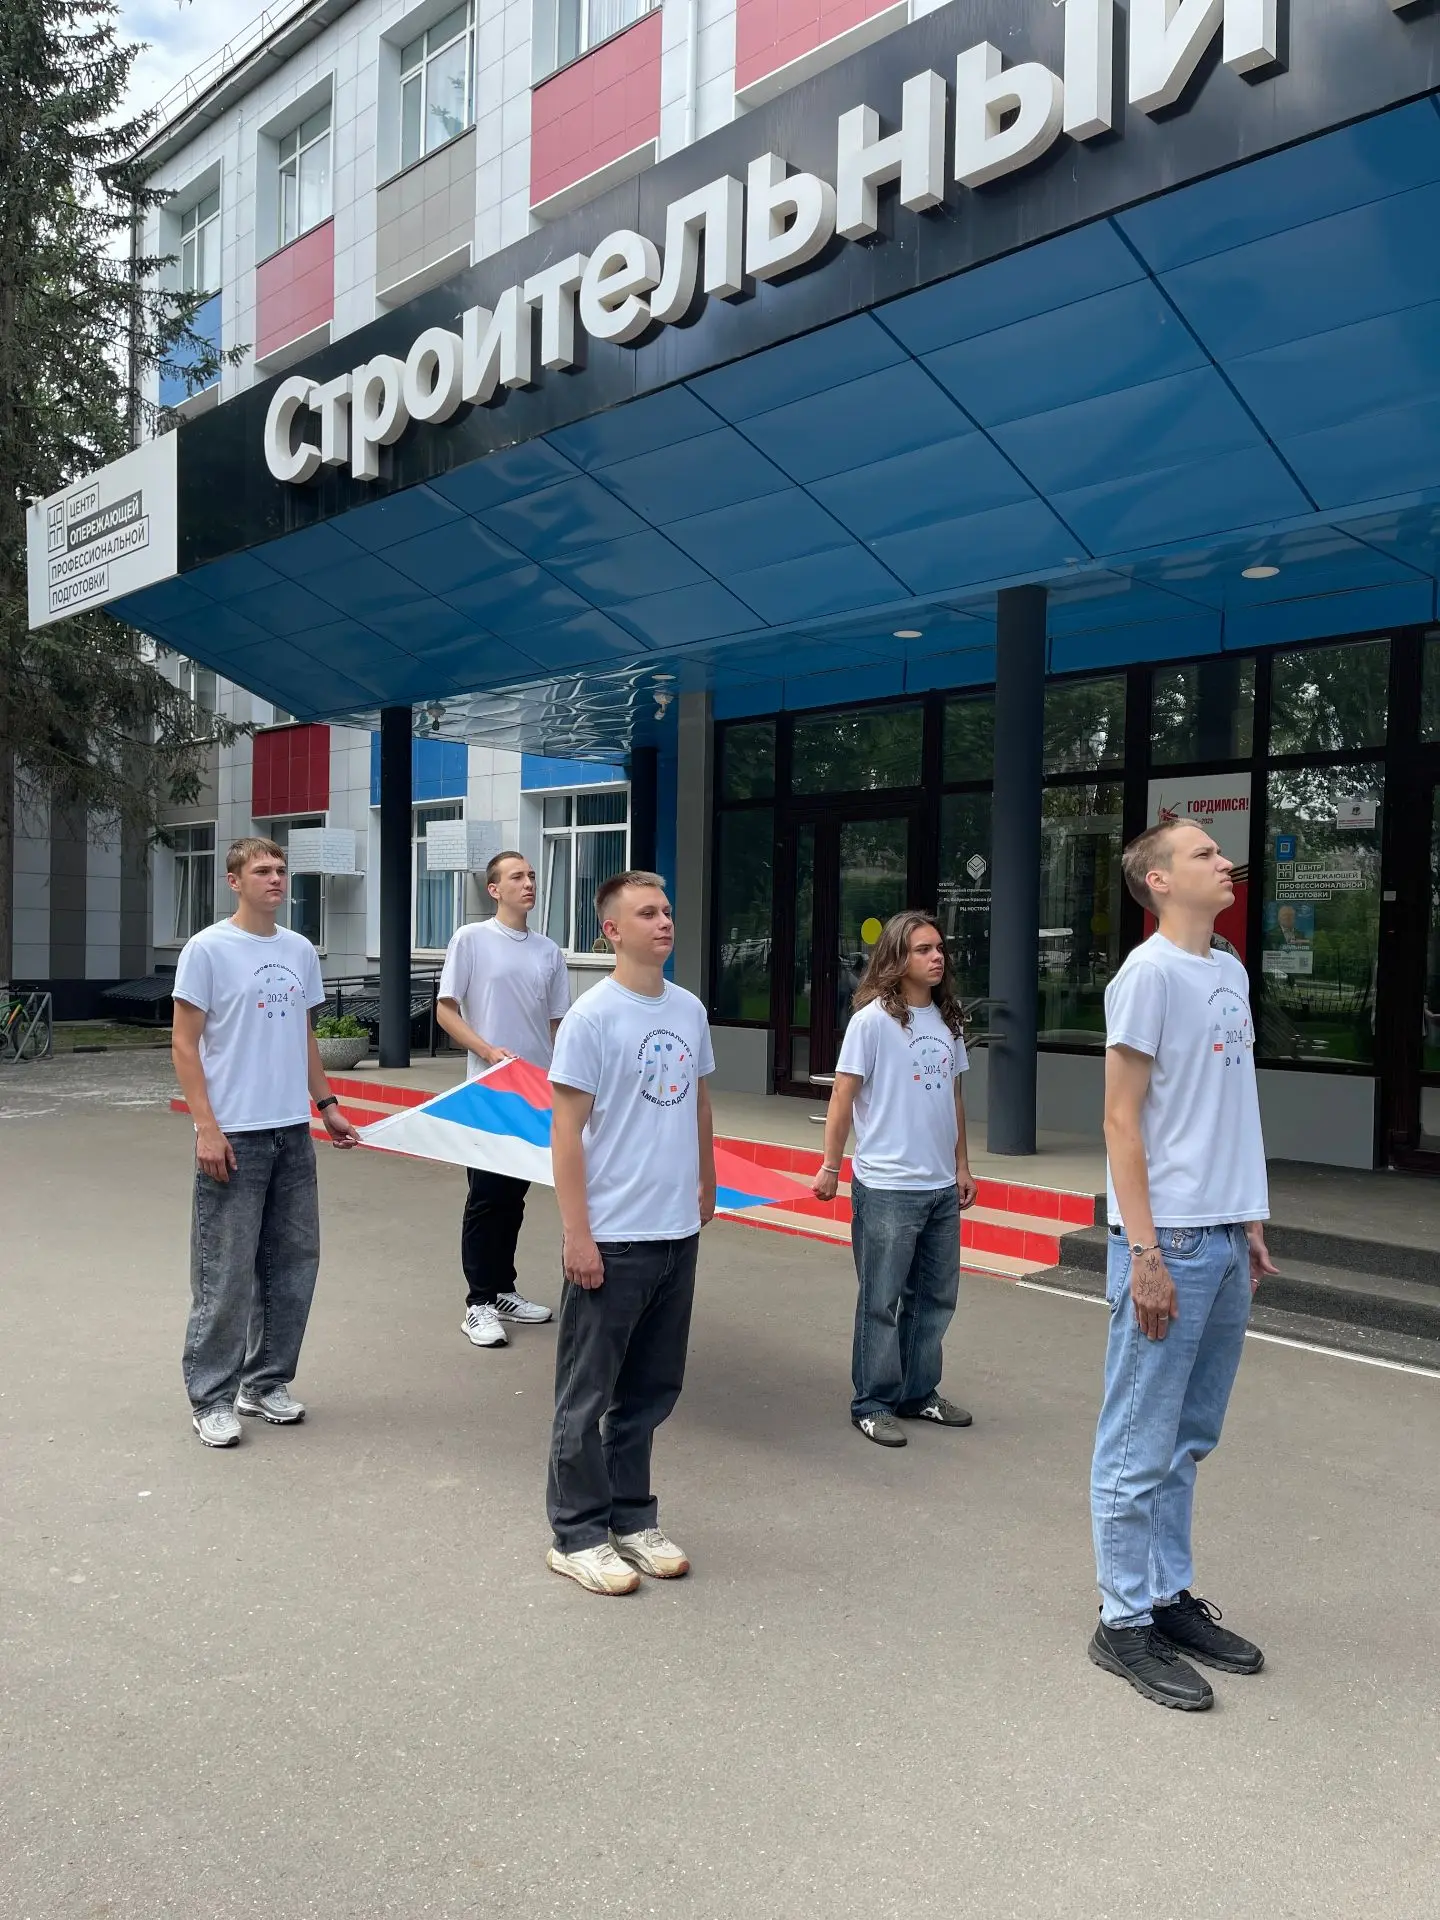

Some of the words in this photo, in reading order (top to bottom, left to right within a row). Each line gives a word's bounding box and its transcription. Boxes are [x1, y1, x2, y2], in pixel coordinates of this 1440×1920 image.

[69, 493, 97, 519] ЦЕНТР
[69, 496, 140, 546] ОПЕРЕЖАЮЩЕЙ
[51, 521, 146, 580] ПРОФЕССИОНАЛЬНОЙ
[52, 571, 106, 606] ПОДГОТОВКИ
[1187, 798, 1249, 814] ГОРДИМСЯ!
[1297, 864, 1322, 872] ЦЕНТР
[1297, 871, 1359, 880] ОПЕРЕЖАЮЩЕЙ
[1279, 881, 1363, 890] ПРОФЕССИОНАЛЬНОЙ
[267, 993, 289, 1003] 2024
[1225, 1029, 1243, 1044] 2024
